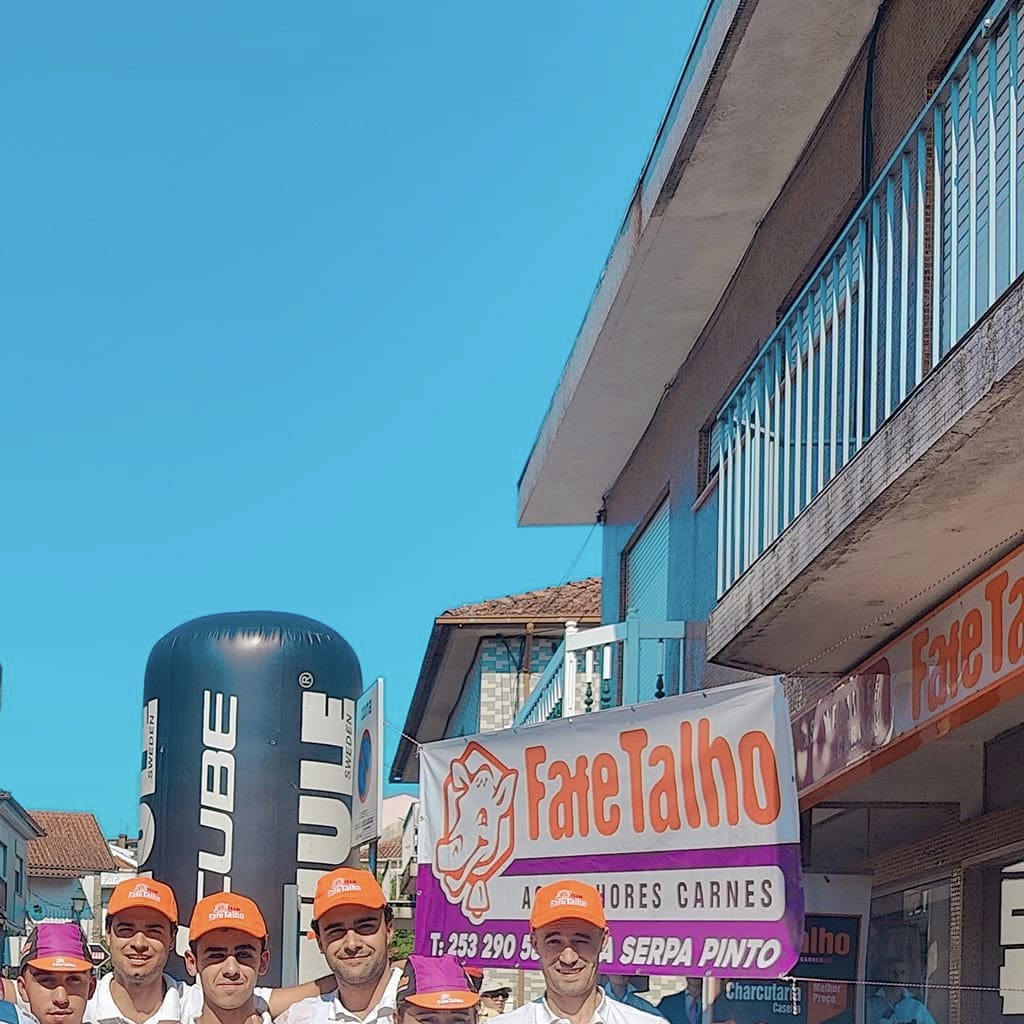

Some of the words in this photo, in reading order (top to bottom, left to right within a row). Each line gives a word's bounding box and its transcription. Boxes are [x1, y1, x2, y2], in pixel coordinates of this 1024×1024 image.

[912, 570, 1024, 720] FafeTa
[147, 714, 155, 780] SWEDEN
[344, 713, 353, 780] SWEDEN
[524, 717, 782, 842] FafeTalho
[678, 878, 773, 909] CARNES
[430, 932, 445, 957] T:
[448, 932, 477, 958] 253
[481, 934, 517, 960] 290
[622, 936, 693, 968] SERPA
[698, 936, 781, 969] PINTO
